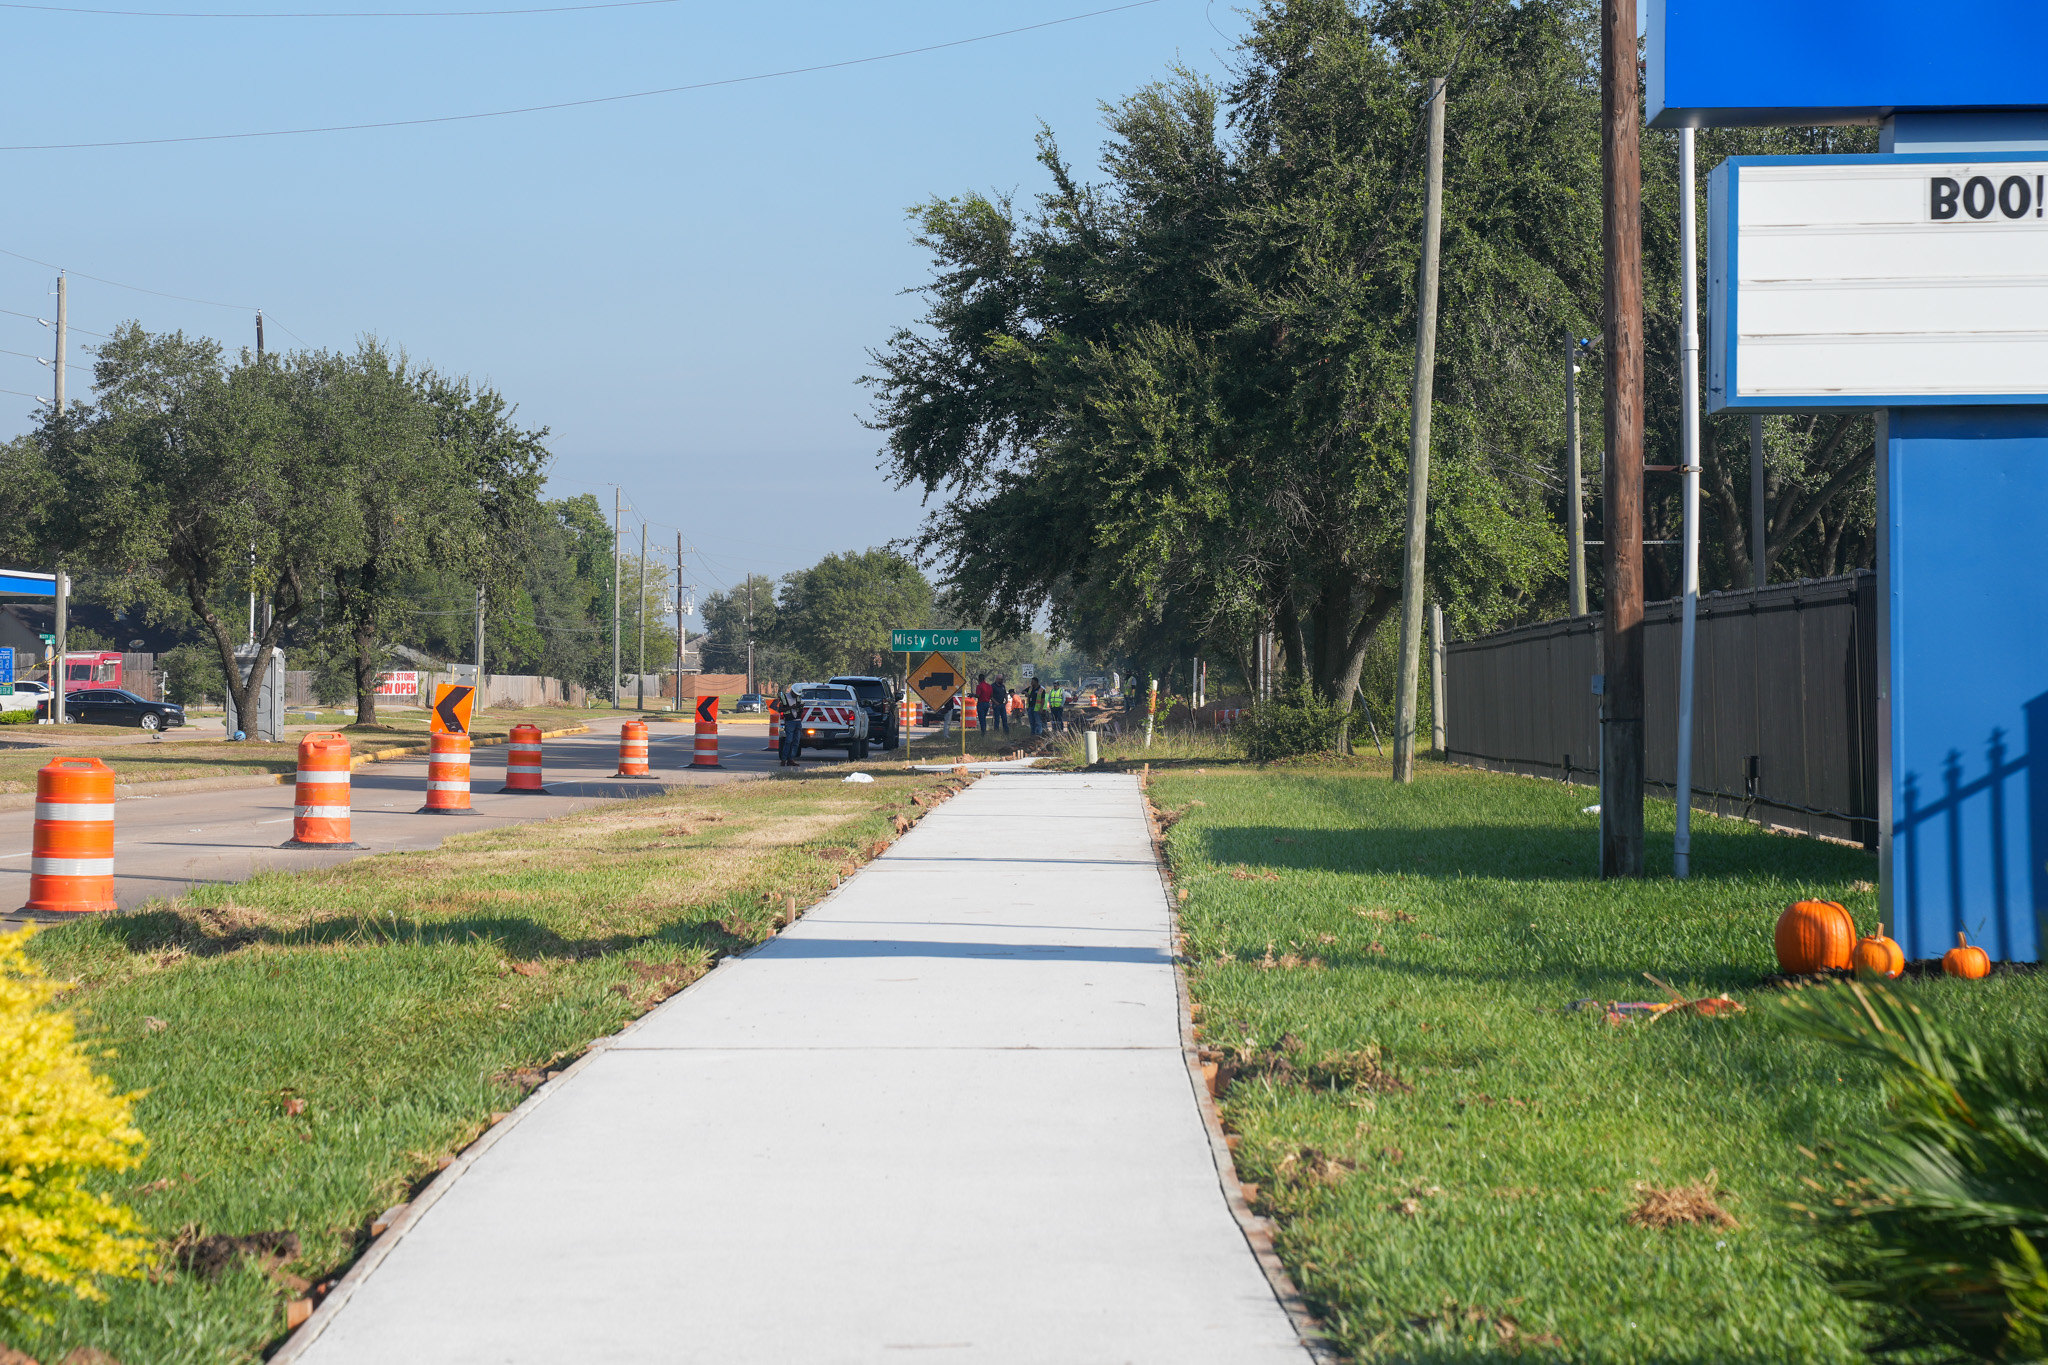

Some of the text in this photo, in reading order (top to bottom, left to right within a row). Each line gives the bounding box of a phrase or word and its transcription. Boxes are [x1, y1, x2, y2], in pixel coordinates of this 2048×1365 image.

[1930, 175, 2046, 219] BOO!
[894, 634, 926, 648] Misty
[932, 634, 959, 646] Cove
[396, 672, 416, 681] STORE
[395, 683, 417, 694] OPEN
